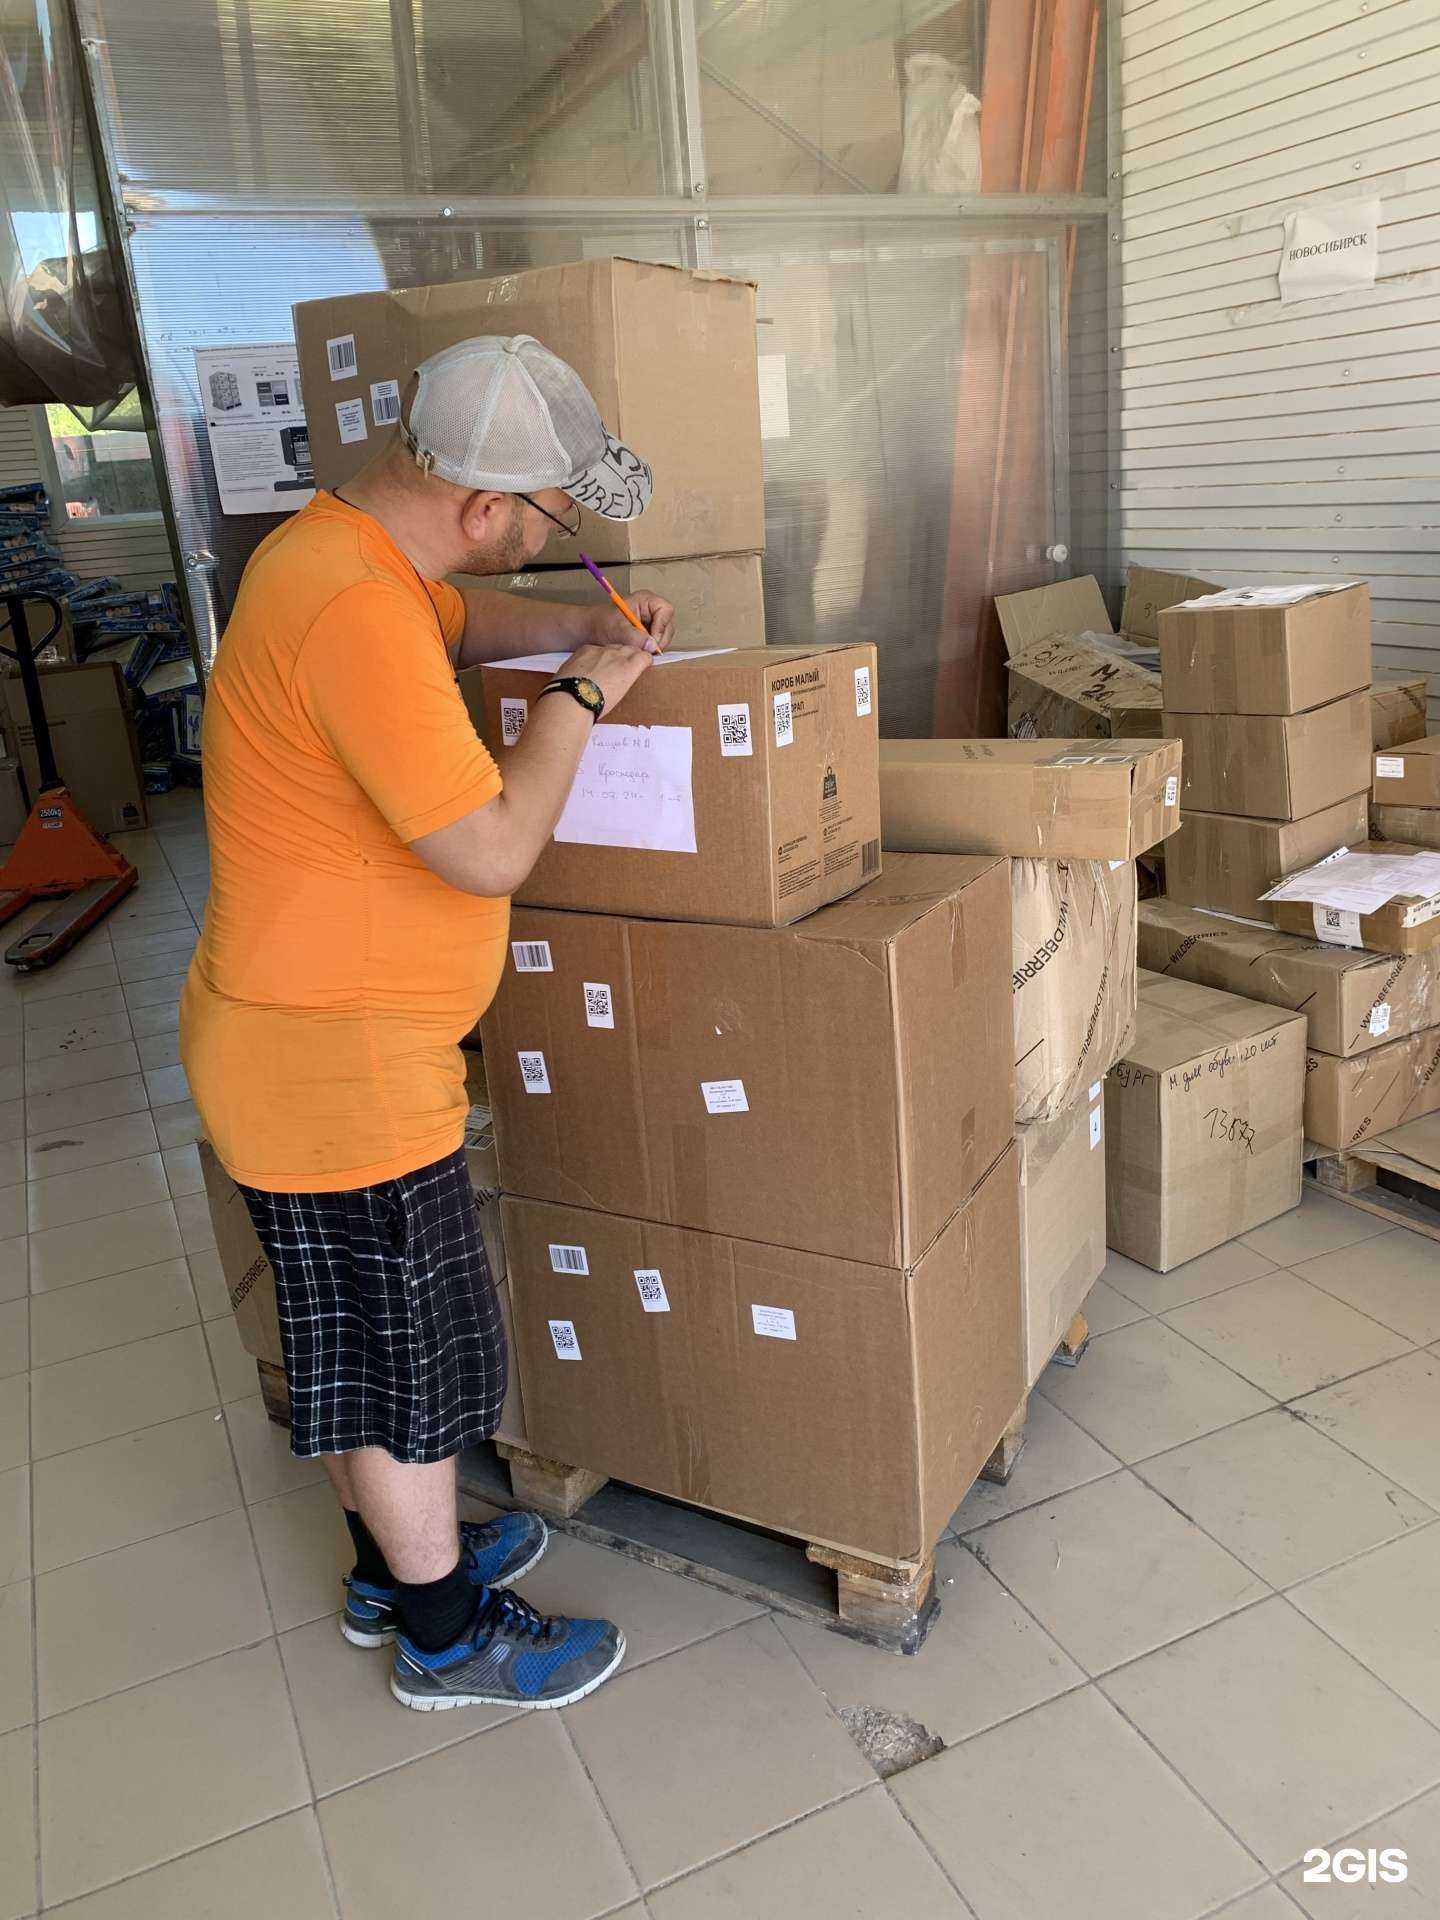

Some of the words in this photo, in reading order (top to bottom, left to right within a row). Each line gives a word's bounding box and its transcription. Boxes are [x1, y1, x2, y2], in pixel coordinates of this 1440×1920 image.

[1289, 233, 1368, 261] НОВОСИБИРСК
[771, 677, 794, 692] КОРОБ
[795, 668, 820, 686] МАЛЫЙ
[1012, 900, 1069, 993] WILDBERRIE
